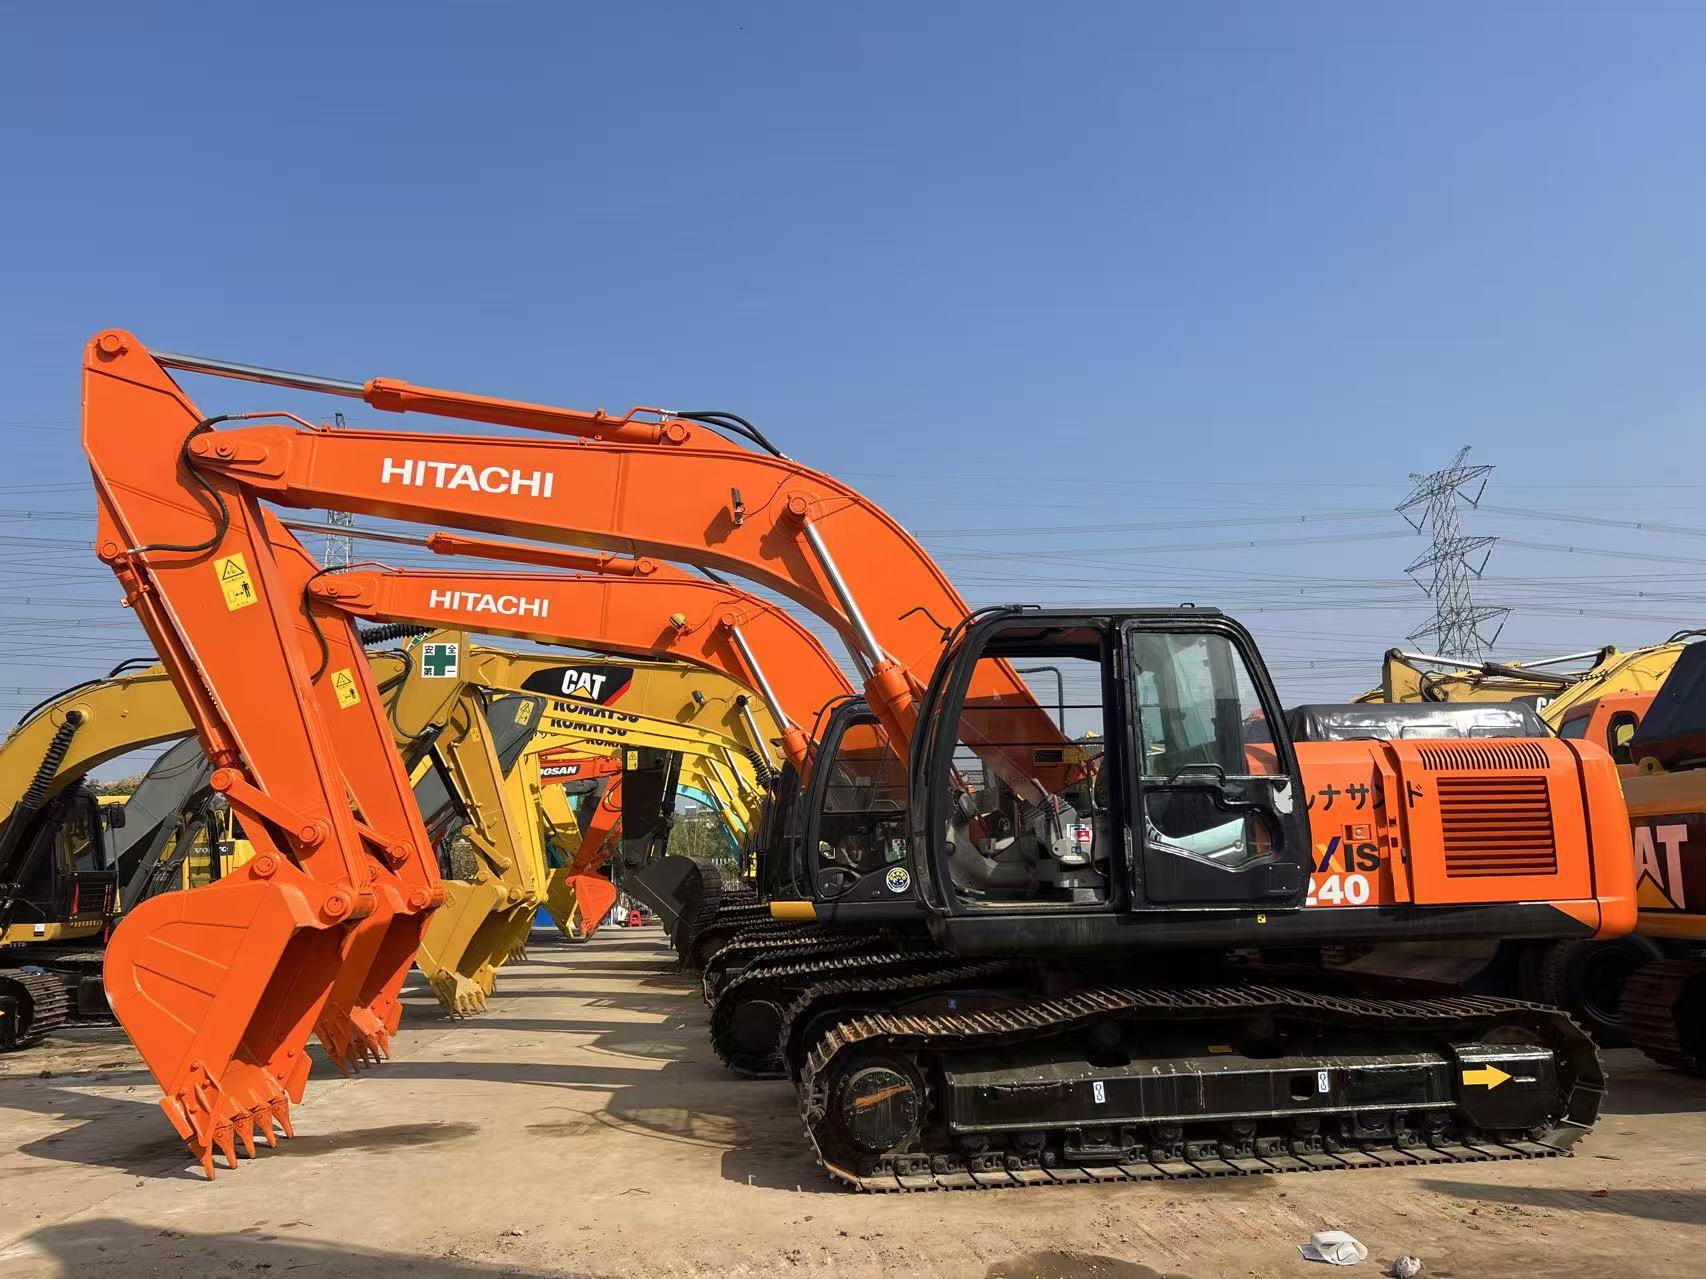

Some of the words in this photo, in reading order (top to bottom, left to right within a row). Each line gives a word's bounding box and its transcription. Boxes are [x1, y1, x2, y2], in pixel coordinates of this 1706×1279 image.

[381, 457, 554, 498] HITACHI
[429, 589, 549, 618] HITACHI
[561, 669, 606, 700] CAT
[1311, 836, 1380, 873] XIS
[1634, 824, 1688, 909] AT
